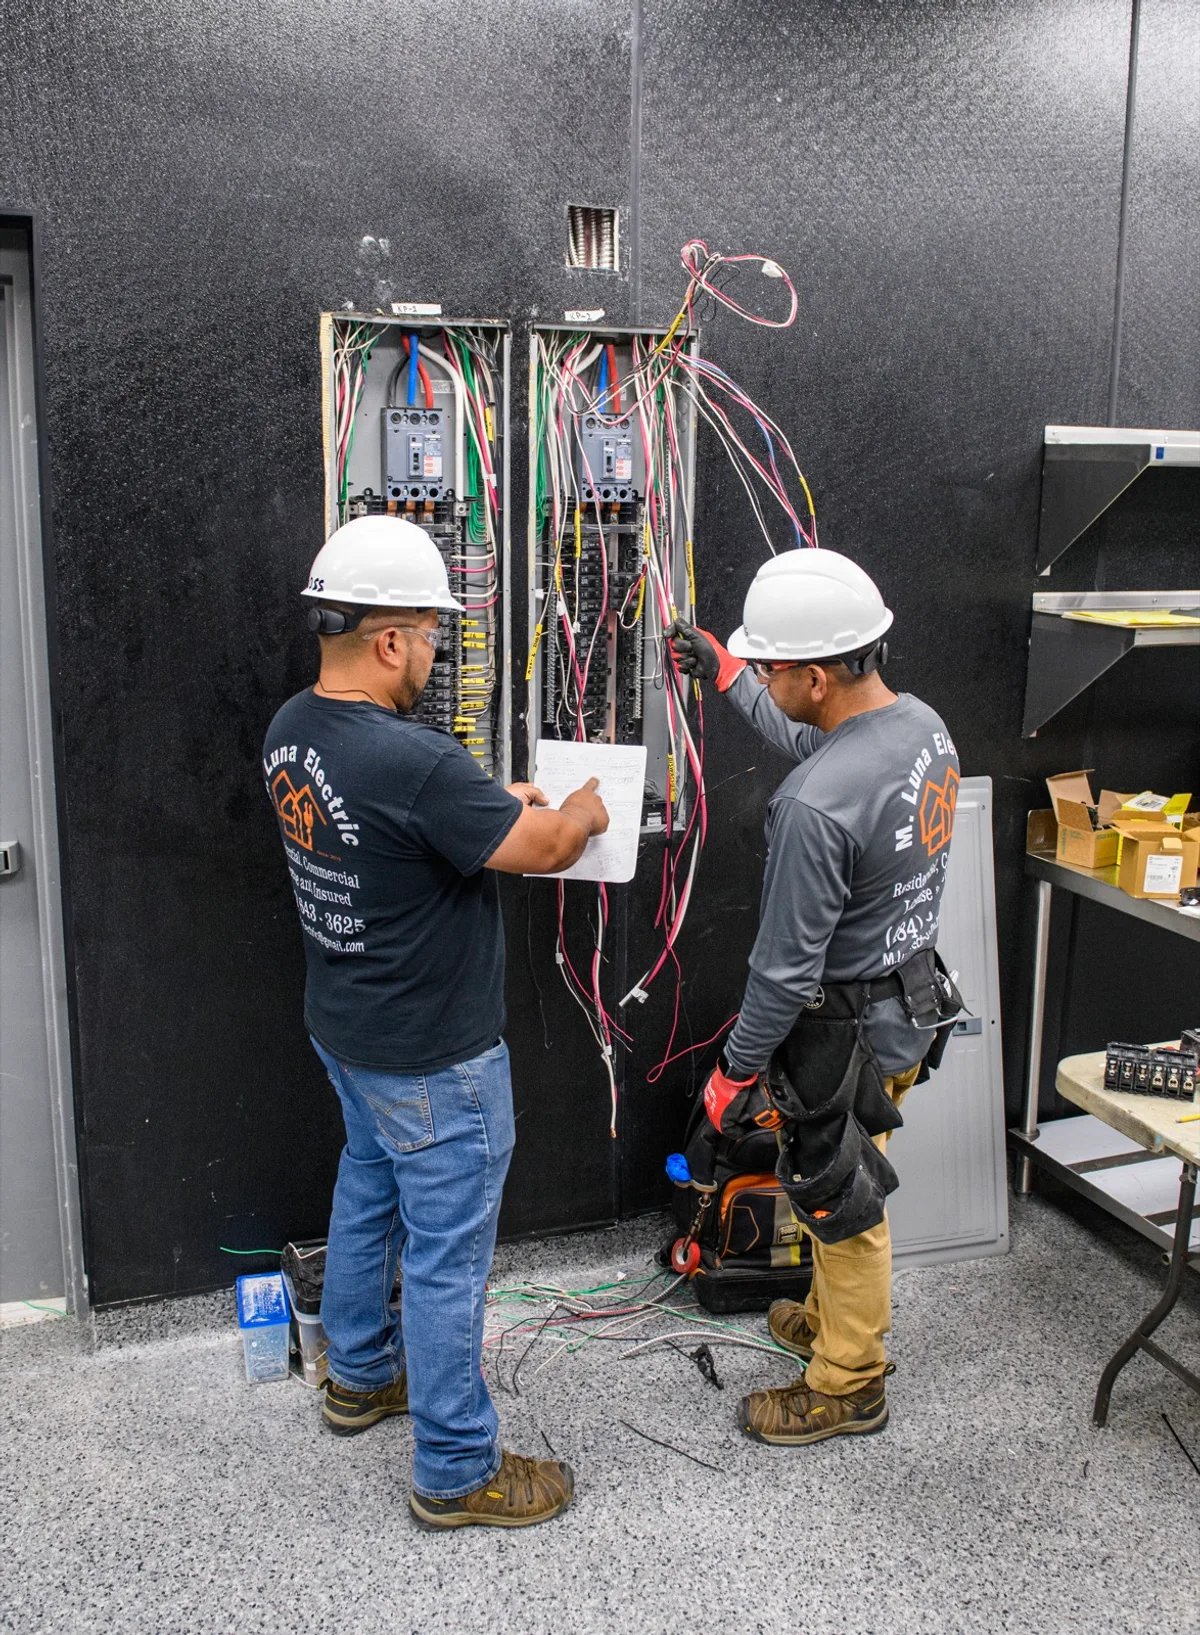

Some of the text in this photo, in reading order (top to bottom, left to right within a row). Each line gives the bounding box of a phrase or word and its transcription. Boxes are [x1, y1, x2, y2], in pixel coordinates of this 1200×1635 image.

[901, 747, 933, 807] Luna
[932, 732, 959, 761] Ele
[263, 744, 361, 848] Luna Electric
[302, 854, 361, 890] Commercial
[312, 881, 353, 908] Insured
[324, 912, 367, 935] 3625
